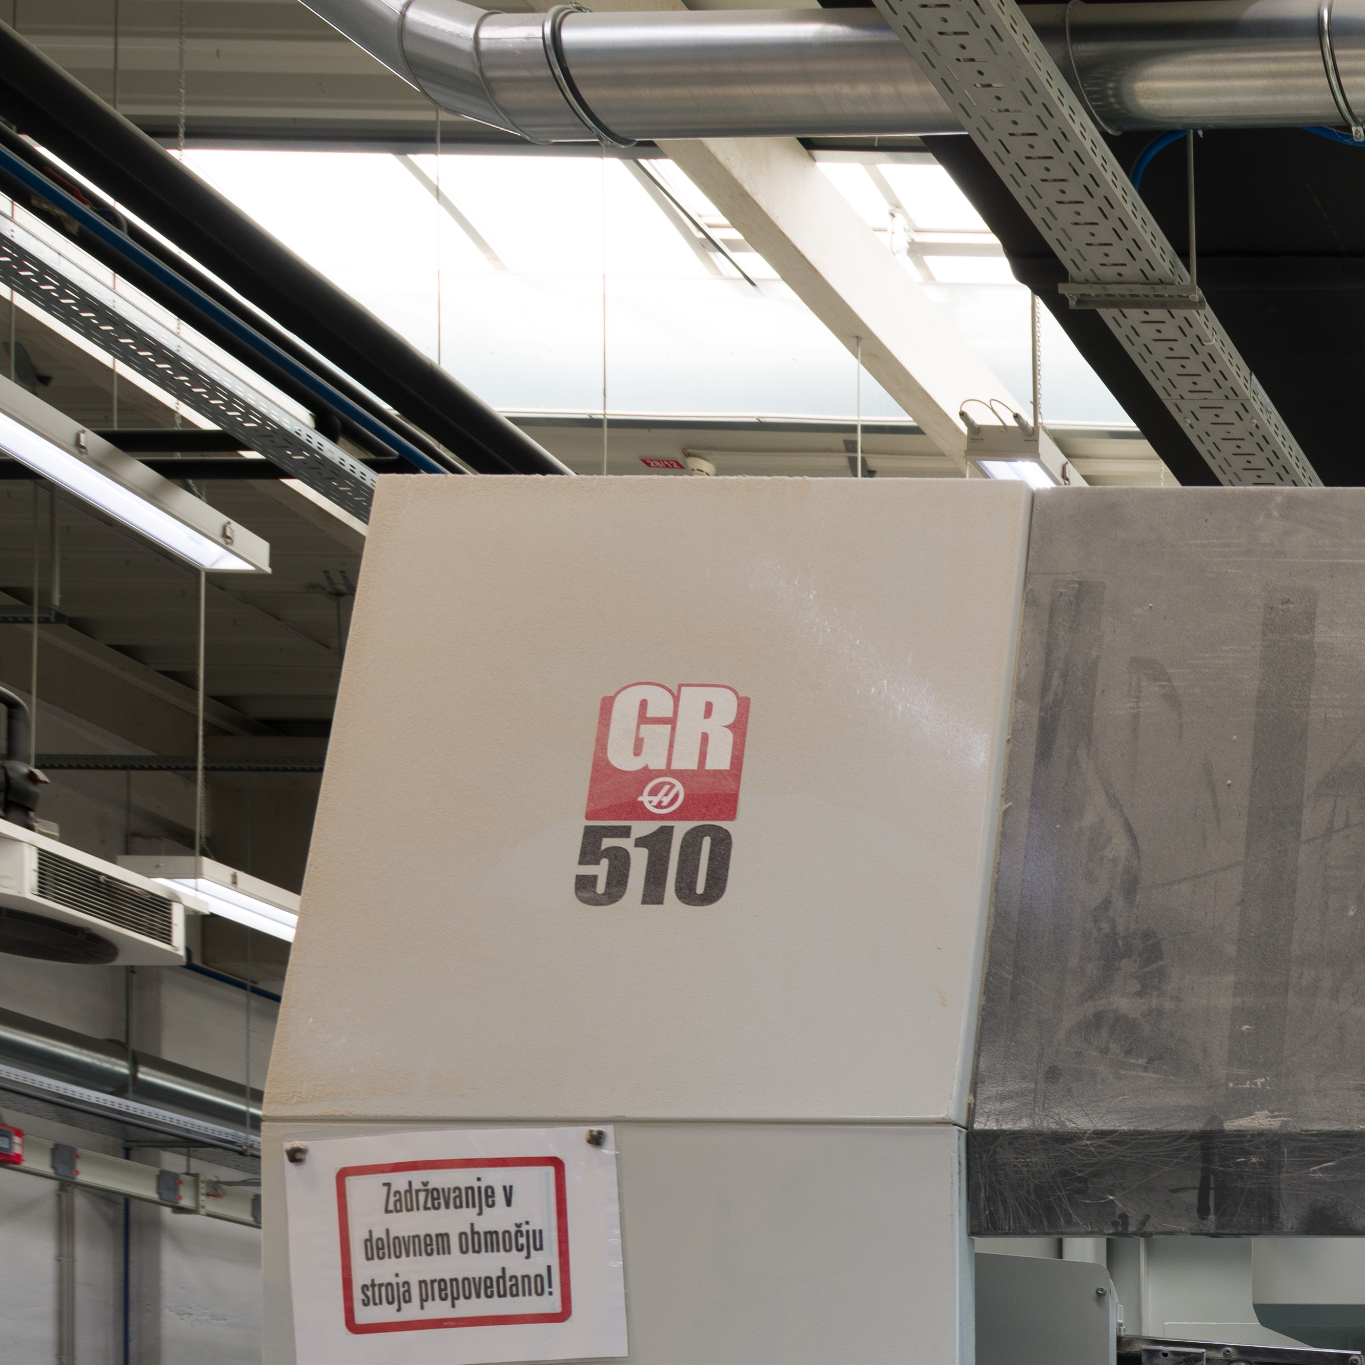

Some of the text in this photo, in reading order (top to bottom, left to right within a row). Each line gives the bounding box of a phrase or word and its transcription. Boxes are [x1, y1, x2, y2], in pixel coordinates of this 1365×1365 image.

[607, 684, 738, 771] GR
[574, 823, 733, 907] 510
[382, 1177, 514, 1216] Zadrževanje v
[363, 1220, 544, 1262] delovnem območju
[360, 1264, 554, 1313] stroja prepovedano!
